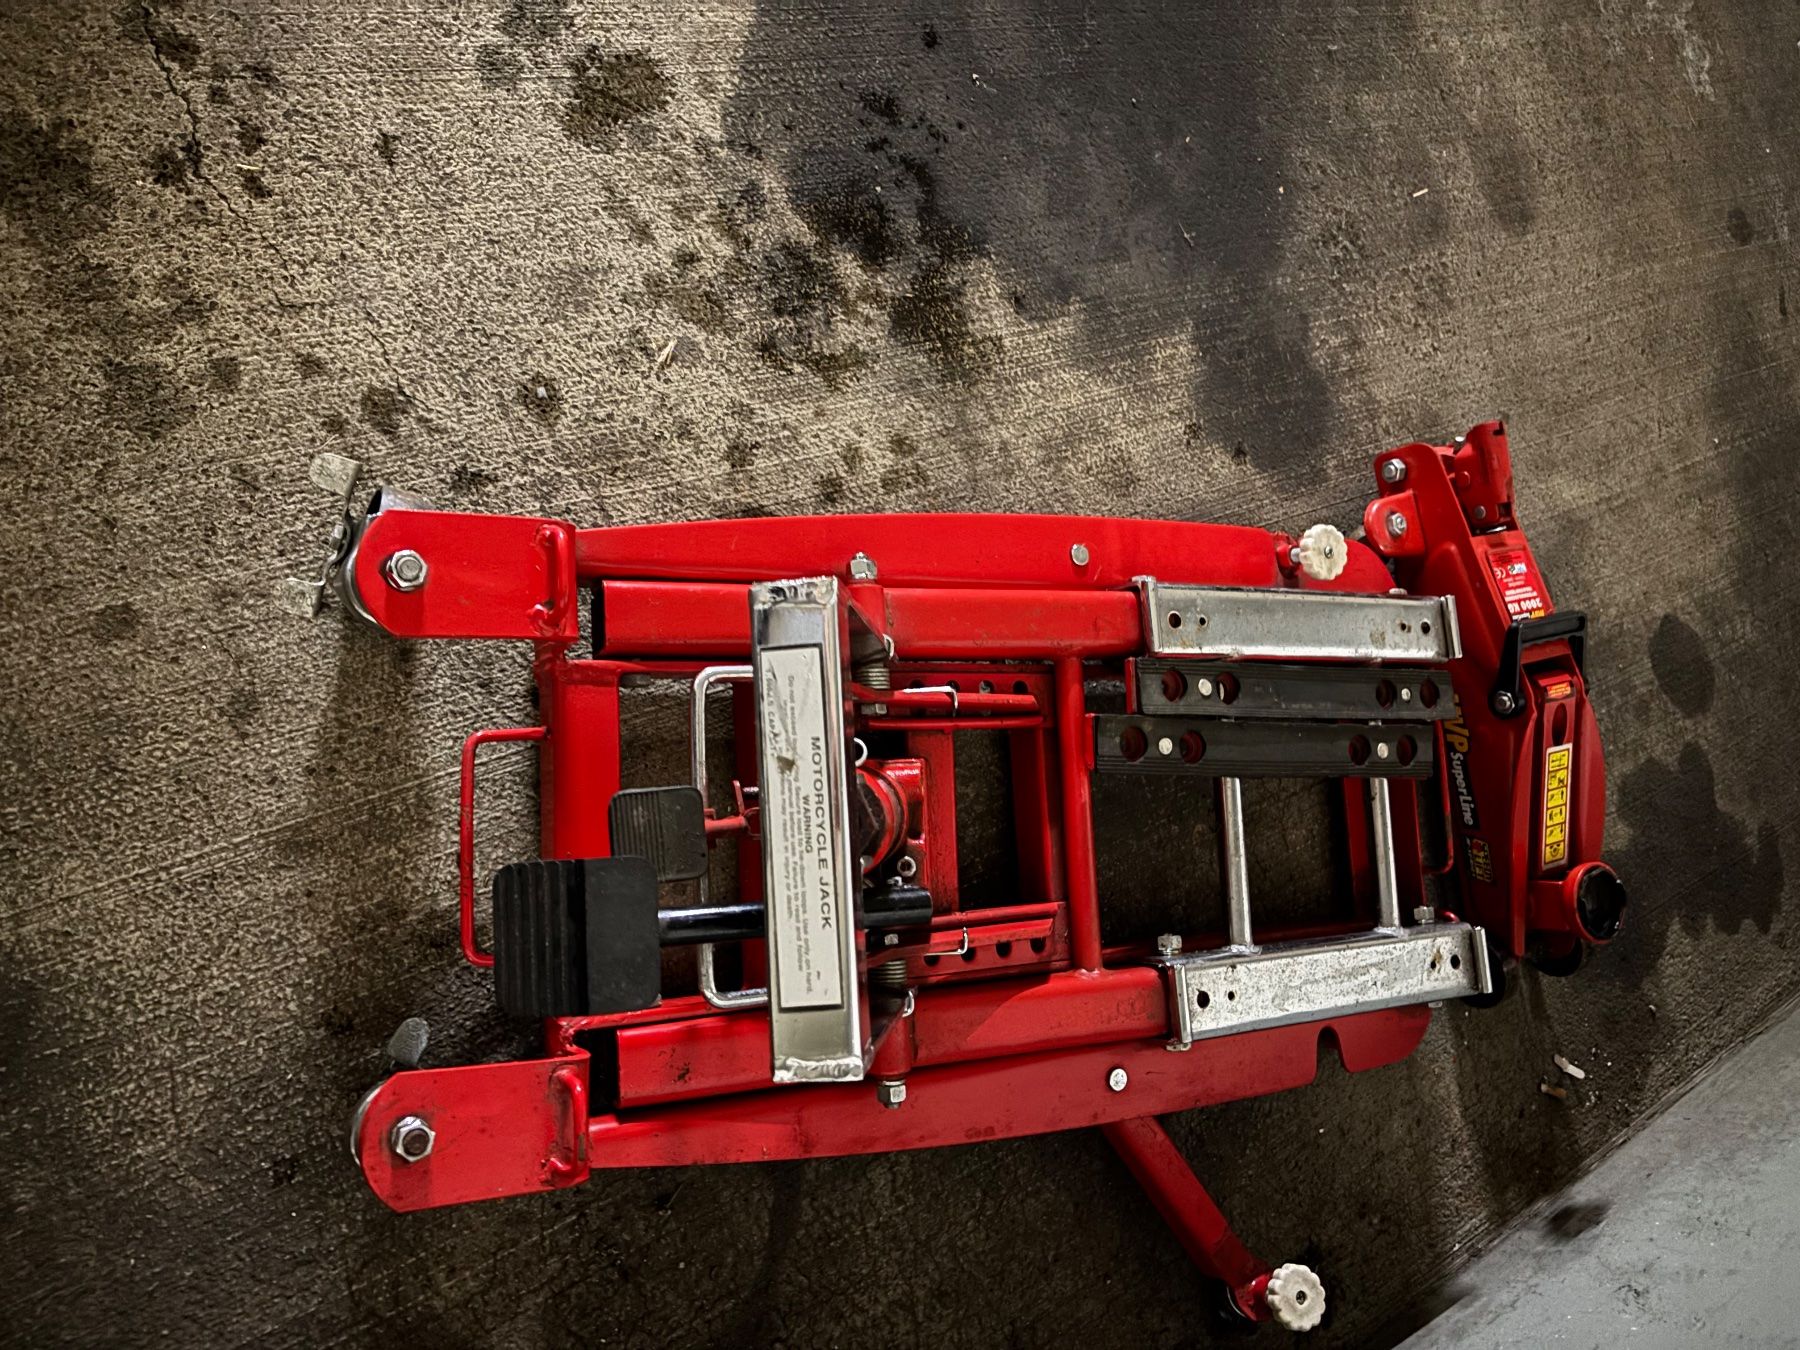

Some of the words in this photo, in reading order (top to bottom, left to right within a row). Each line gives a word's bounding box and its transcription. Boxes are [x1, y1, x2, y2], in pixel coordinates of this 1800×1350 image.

[1507, 603, 1520, 614] KG
[1520, 598, 1542, 611] 2000
[788, 675, 794, 686] Do
[1450, 751, 1475, 826] SuperLine
[794, 786, 802, 814] Secure
[802, 795, 812, 853] WARNING
[810, 736, 828, 869] MOTORCYCLE
[819, 876, 831, 929] JACK
[797, 838, 804, 847] to
[793, 892, 799, 901] to
[801, 937, 810, 955] only
[804, 958, 811, 969] on
